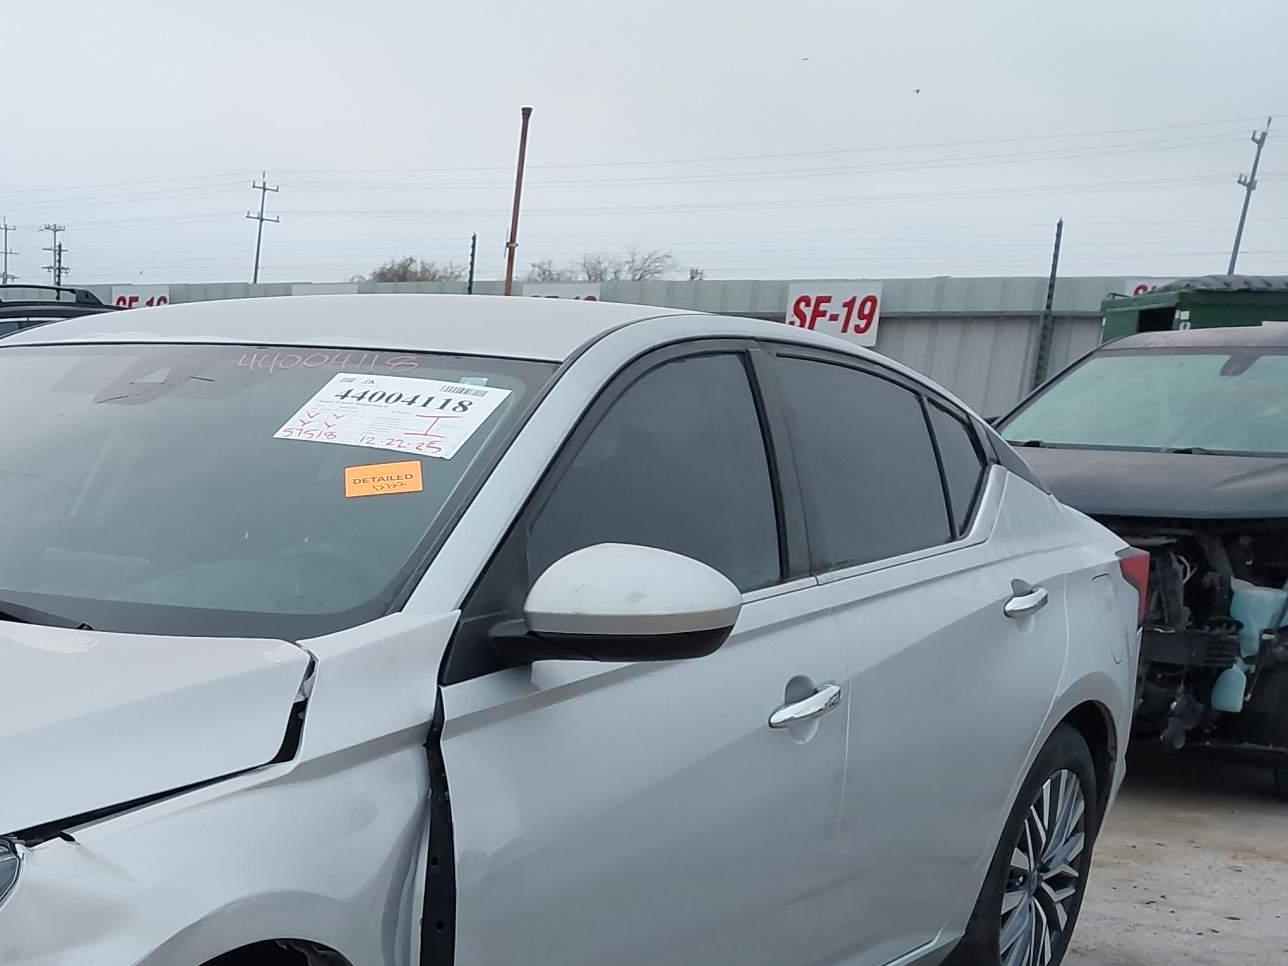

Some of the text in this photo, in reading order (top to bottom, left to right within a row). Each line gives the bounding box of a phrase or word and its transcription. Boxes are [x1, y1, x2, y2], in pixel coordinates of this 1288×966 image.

[789, 295, 878, 334] SF-19
[238, 351, 419, 374] 44004118
[334, 388, 473, 413] 44004118
[353, 473, 414, 485] DETAILED
